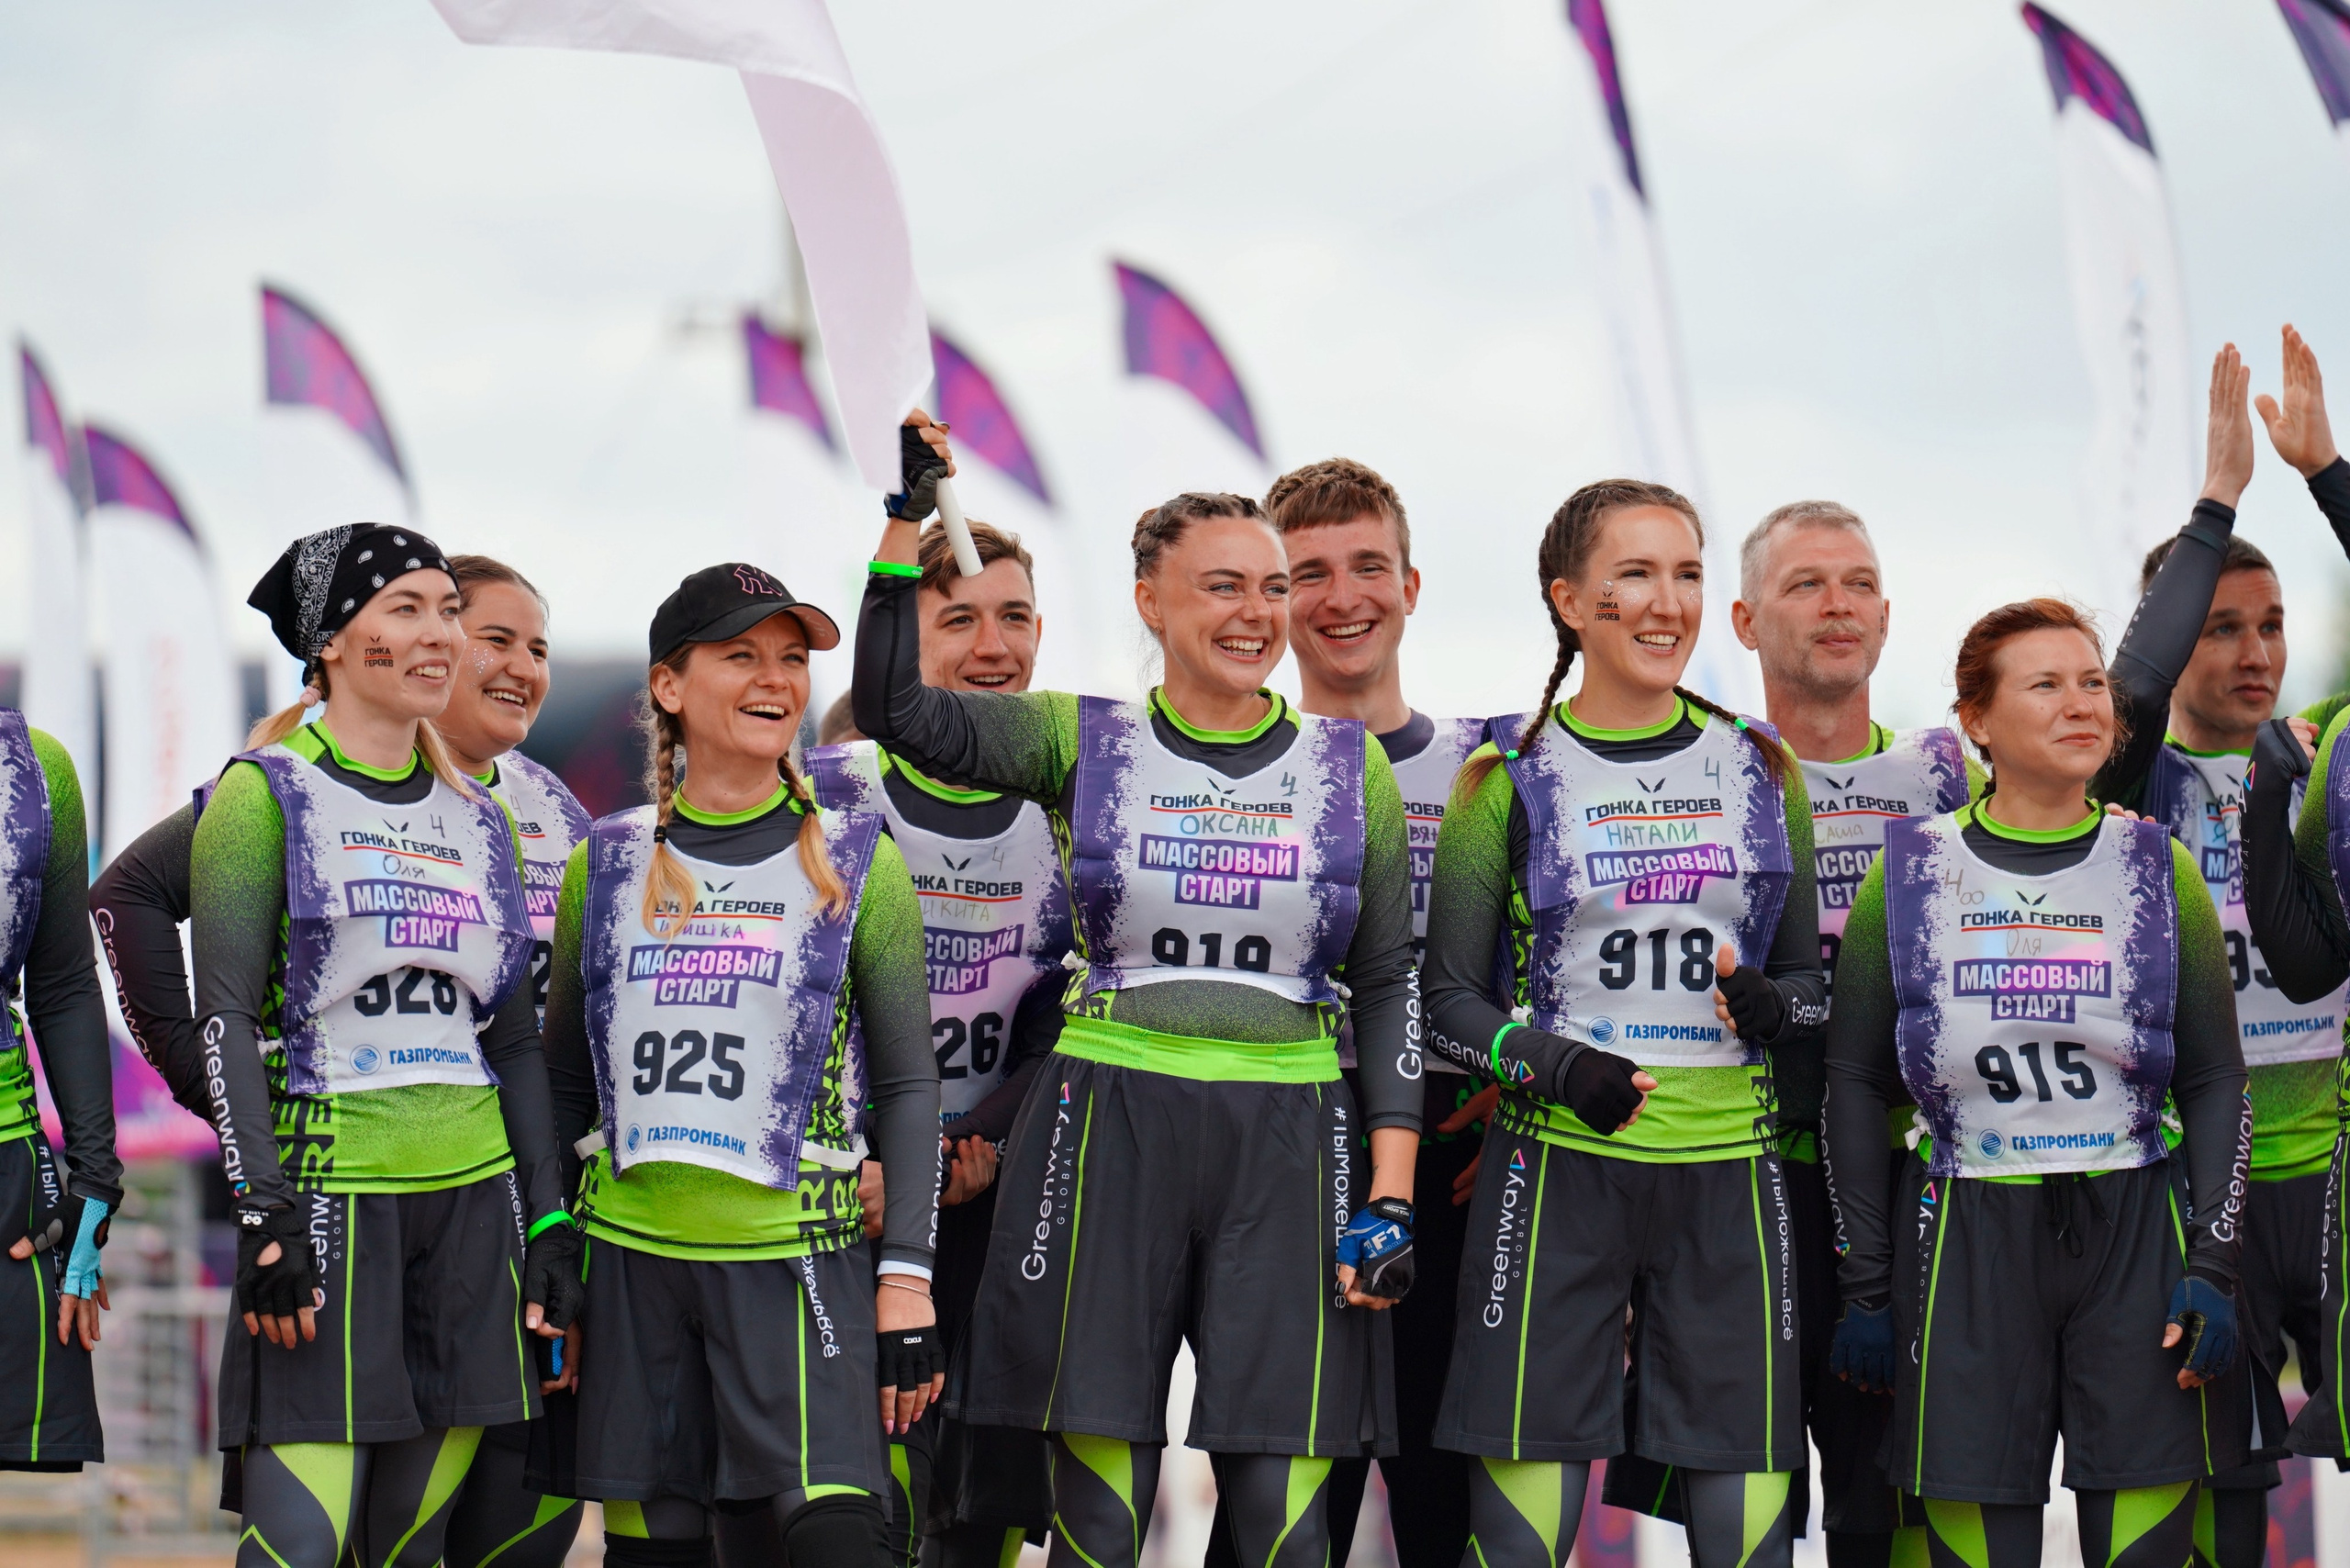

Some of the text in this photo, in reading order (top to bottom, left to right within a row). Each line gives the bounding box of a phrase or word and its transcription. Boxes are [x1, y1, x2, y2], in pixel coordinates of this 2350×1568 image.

[1595, 612, 1620, 621] ГЕРОЕВ
[364, 646, 391, 655] ГОНКА
[364, 658, 394, 667] ГЕРОЕВ
[1150, 793, 1292, 813] ГОНКА ГЕРОЕВ
[1585, 798, 1722, 822] ГОНКА ГЕРОЕВ
[1811, 795, 1909, 814] КА ГЕРОЕВ
[1181, 813, 1279, 837] ОКСАНА
[1606, 822, 1698, 847] НАТАЛИ
[341, 831, 462, 860] ГОНКА ГЕРОЕВ
[1146, 839, 1292, 876] МАССОВЫЙ
[383, 854, 426, 879] Оля
[1593, 844, 1732, 881] МАССОВЫЙ
[954, 879, 1024, 897] ГЕРОЕВ
[1181, 874, 1255, 905] СТАРТ
[1630, 873, 1700, 901] СТАРТ
[351, 883, 482, 922] МАССОВЫЙ
[711, 900, 786, 915] ГЕРОЕВ
[922, 899, 990, 922] ИКИТА
[390, 916, 455, 948] СТАРТ
[1961, 910, 2104, 928] ГОНКА ГЕРОЕВ
[2006, 928, 2042, 958] Оля
[632, 946, 777, 980] МАССОВЫЙ
[1598, 927, 1714, 992] 918
[1960, 958, 2105, 992] МАССОВЫЙ
[659, 978, 735, 1004] СТАРТ
[1996, 994, 2070, 1020] СТАРТ
[1625, 1025, 1722, 1043] ГАЗПРОМБАНК
[2243, 1014, 2335, 1038] ГАЗПРОМБАНК
[389, 1047, 473, 1065] ГАЗПРОМБАНК
[632, 1029, 745, 1102] 925
[1975, 1040, 2098, 1103] 915
[647, 1126, 747, 1157] ГАЗПРОМБАНК
[2011, 1132, 2115, 1150] ГАЗПРОМБАНК
[1021, 1108, 1070, 1281] Greenway
[1057, 1146, 1074, 1226] GLOBAL
[1483, 1170, 1526, 1328] Greenway
[1513, 1206, 1528, 1279] GLOBAL
